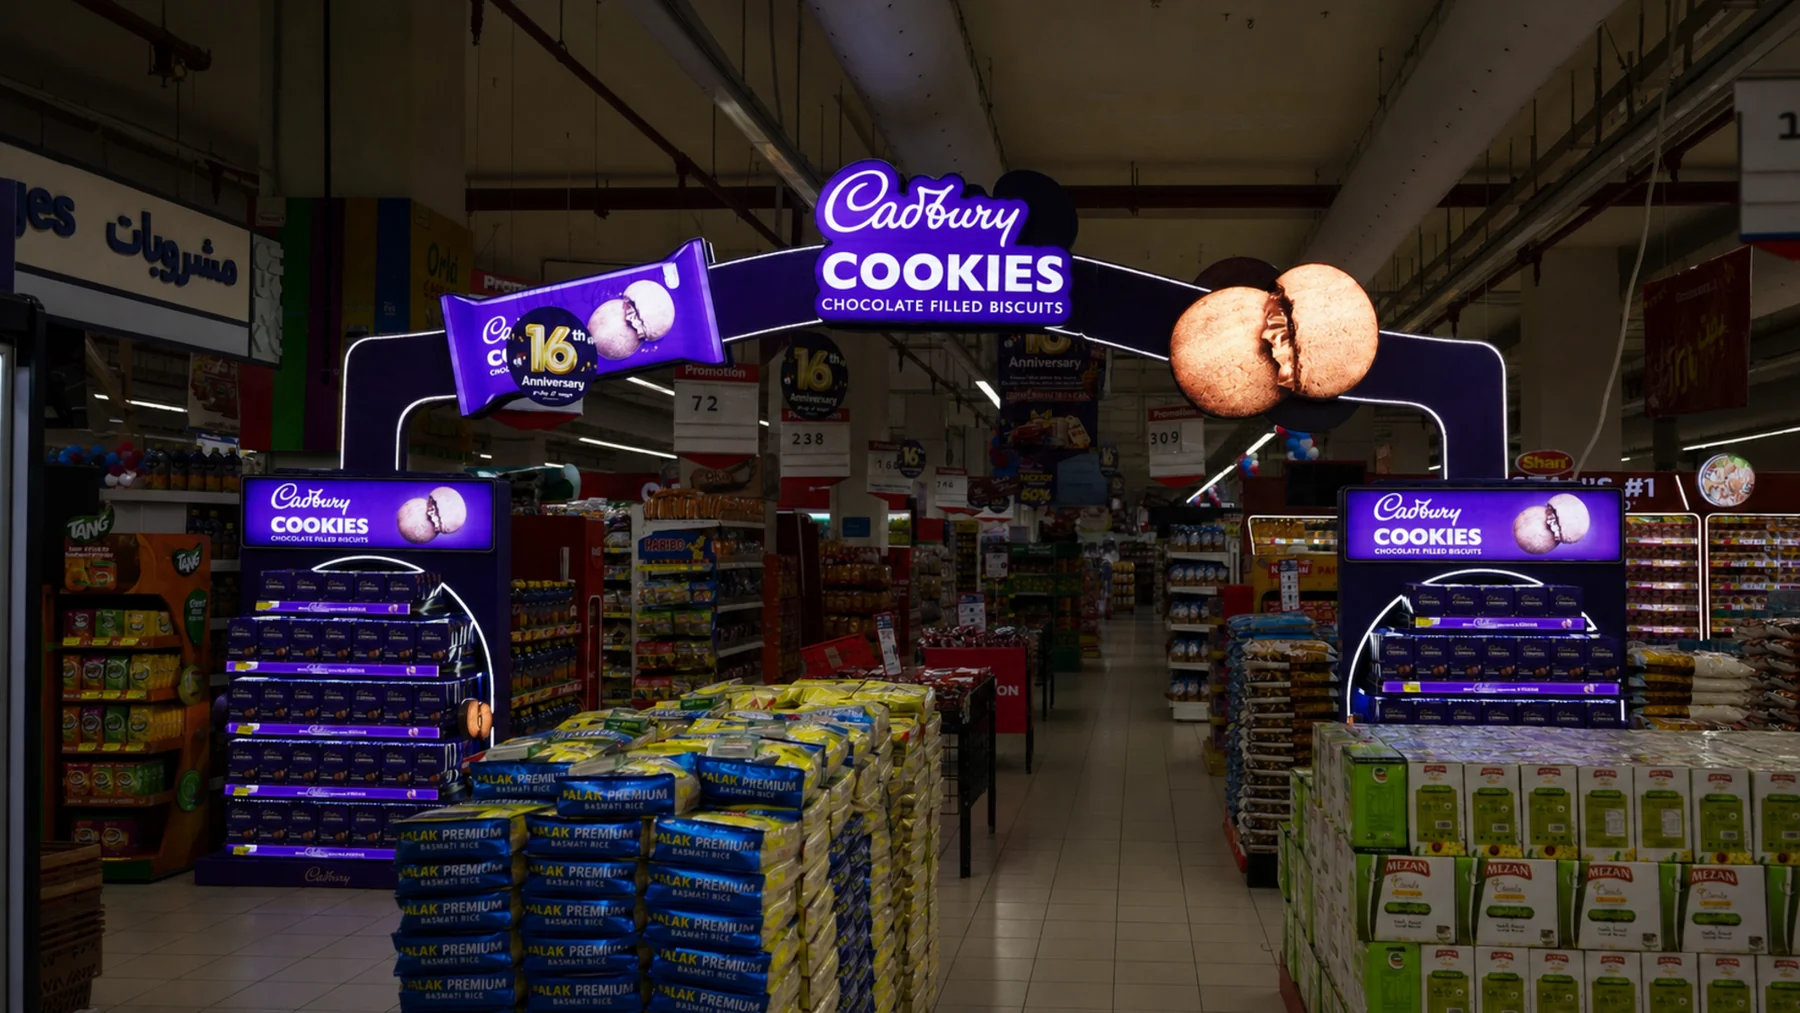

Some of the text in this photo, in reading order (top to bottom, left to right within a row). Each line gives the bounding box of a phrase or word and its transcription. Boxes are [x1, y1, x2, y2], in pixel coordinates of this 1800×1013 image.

[823, 169, 1021, 248] Cadbury
[105, 210, 239, 287] مشروبات
[821, 251, 1065, 293] COOKIES
[821, 297, 1064, 315] CHOCOLATE FILLED BISCUITS
[1008, 356, 1082, 371] Anniversary
[684, 364, 747, 379] Promotion
[521, 375, 585, 392] Anniversary
[691, 395, 719, 412] 72
[789, 392, 838, 407] Anniversary
[791, 432, 825, 445] 238
[1150, 431, 1180, 445] 309
[1523, 456, 1567, 469] Shan
[271, 482, 351, 516] Cadbury
[1373, 492, 1462, 526] Cadbury
[66, 516, 109, 540] TANG
[270, 516, 369, 534] COOKIES
[270, 535, 314, 543] CHOCOLATE
[338, 536, 369, 544] BISCUITS
[1373, 527, 1482, 546] COOKIES
[645, 538, 685, 551] HARIBO
[1448, 548, 1482, 556] BISCUITS
[176, 550, 201, 573] TANG
[496, 785, 551, 793] BASMATI RICE
[741, 777, 797, 792] PREMIUM
[607, 788, 668, 801] PREMIUM
[720, 786, 776, 799] BASMATI RICE
[584, 802, 645, 811] BASMATI RICE
[441, 827, 502, 841] PREMIUM
[574, 827, 633, 840] PREMIUM
[420, 841, 480, 851] BASMATI RICE
[551, 838, 609, 849] BASMATI RICE
[695, 837, 756, 851] PREMIUM
[672, 848, 731, 860] BASMATI RICE
[443, 863, 503, 876] PREMIUM
[568, 866, 628, 878] PREMIUM
[1386, 860, 1428, 874] MEZAN
[1485, 862, 1533, 880] MEZAN
[1587, 866, 1633, 883] MEZAN
[1690, 868, 1738, 886] MEZAN
[420, 877, 480, 887] BASMATI RICE
[546, 877, 605, 888] BASMATI RICE
[695, 878, 756, 893] PREMIUM
[672, 889, 732, 902] BASMATI RICE
[442, 899, 503, 913] PREMIUM
[566, 904, 625, 917] PREMIUM
[421, 914, 480, 925] BASMATI RICE
[544, 916, 604, 927] BASMATI RICE
[693, 918, 754, 933] PREMIUM
[670, 929, 730, 942] BASMATI RICE
[442, 940, 503, 954] PREMIUM
[569, 945, 629, 957] PREMIUM
[421, 955, 480, 966] BASMATI RICE
[548, 956, 607, 966] BASMATI RICE
[702, 955, 762, 973] PREMIUM
[677, 966, 737, 980] BASMATI RICE
[447, 978, 507, 991] PREMIUM
[575, 983, 634, 997] PREMIUM
[425, 991, 483, 1001] BASMATI RICE
[553, 996, 612, 1006] BASMATI RICE
[699, 992, 761, 1012] PREMIUM
